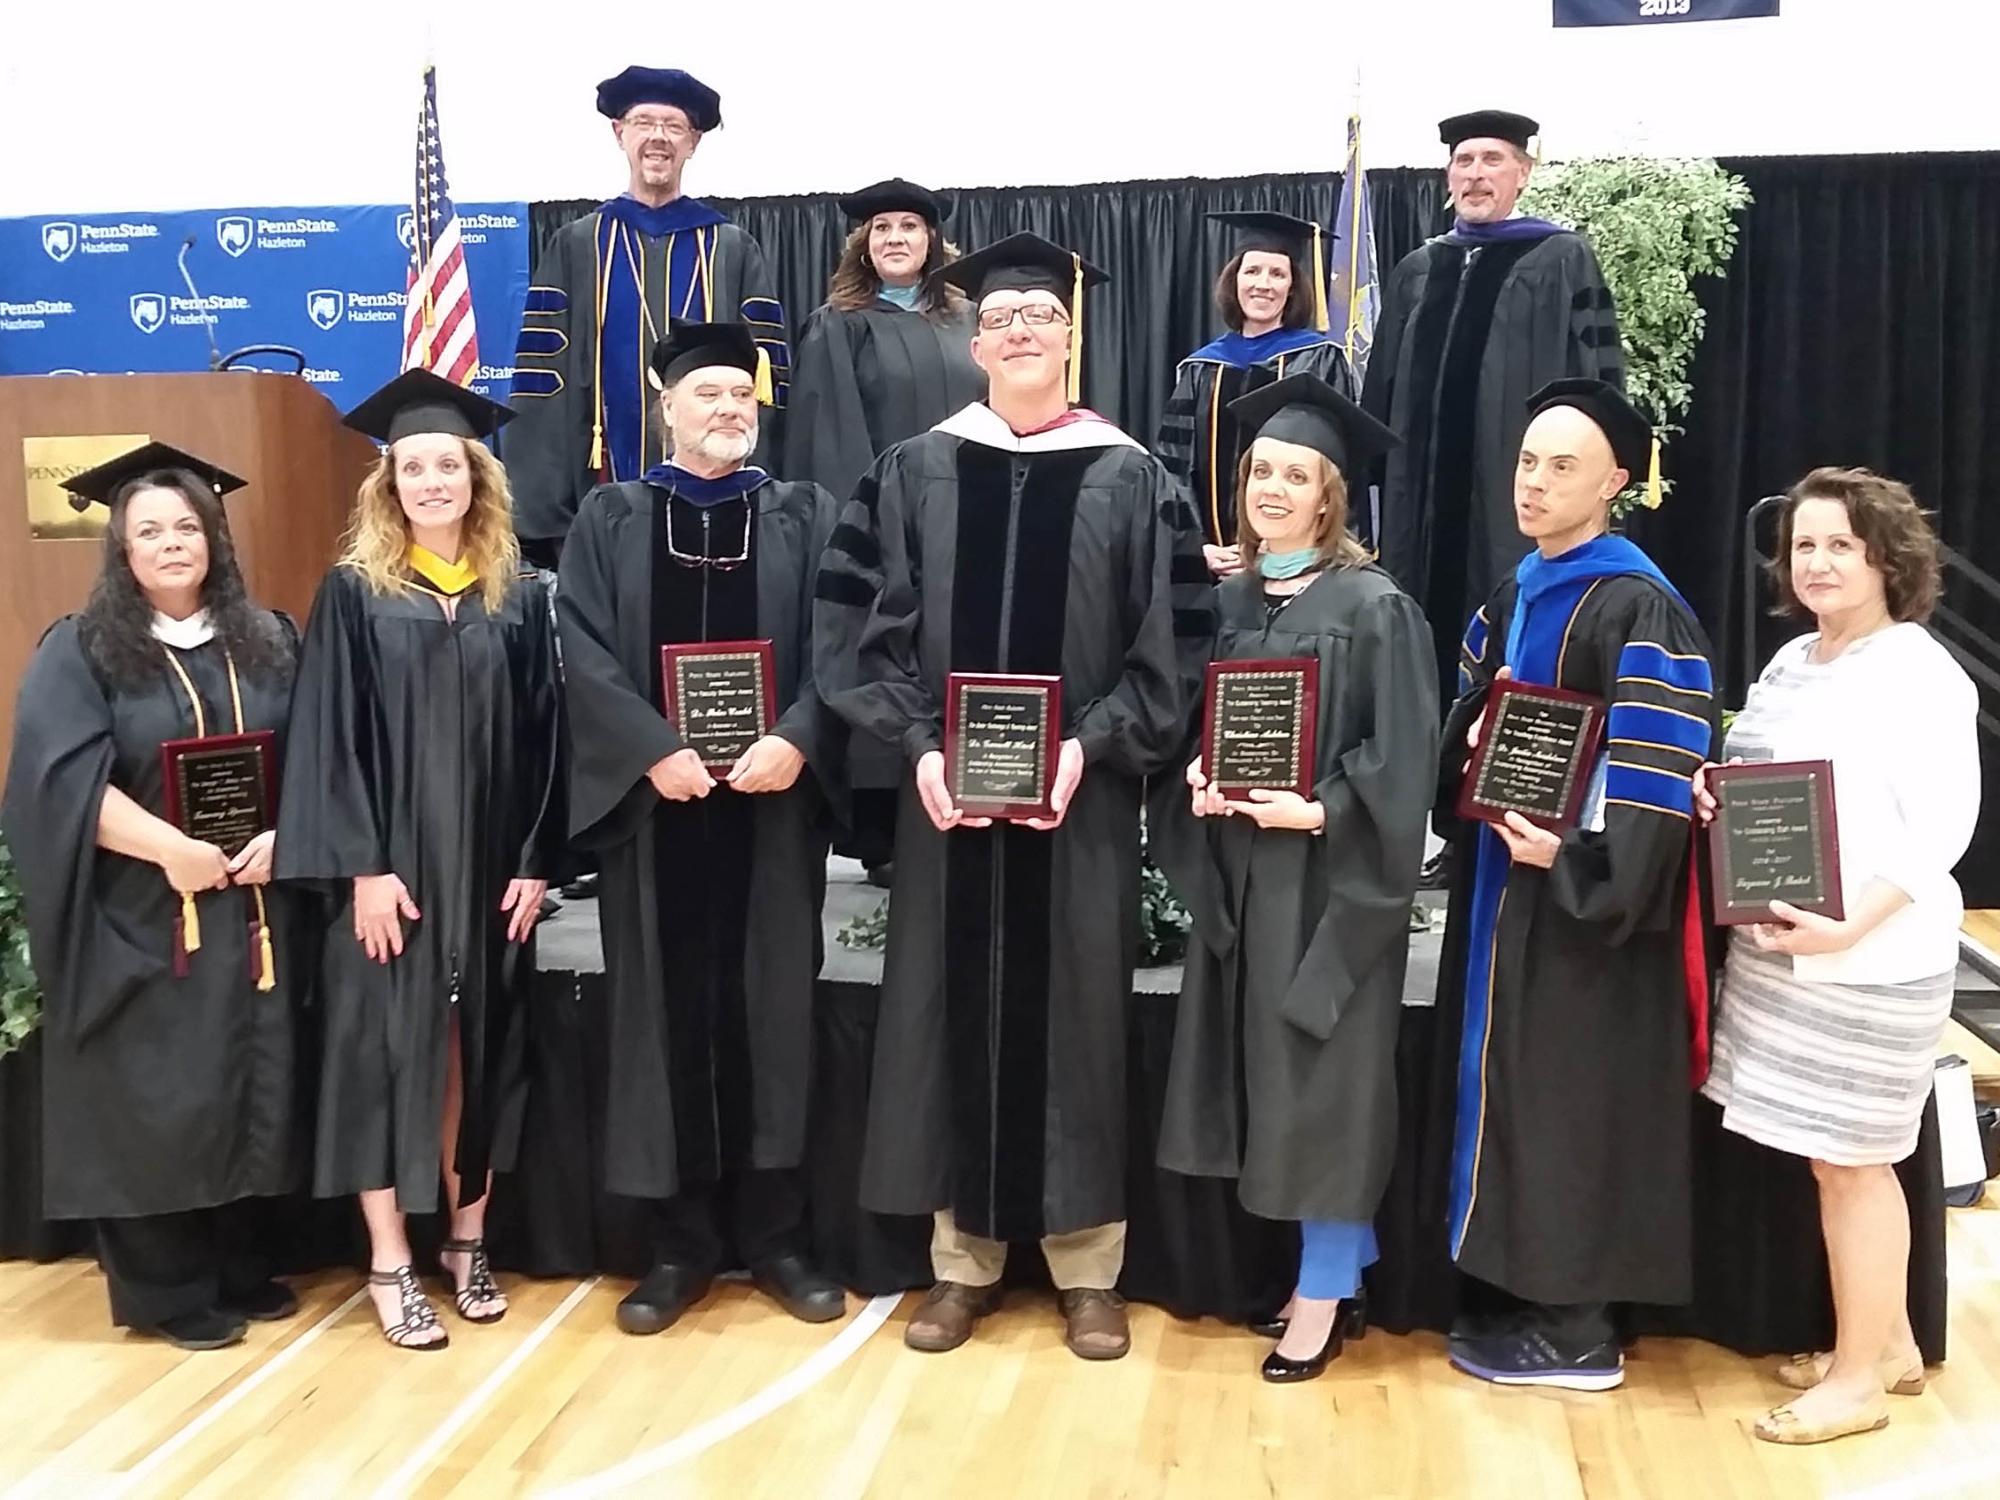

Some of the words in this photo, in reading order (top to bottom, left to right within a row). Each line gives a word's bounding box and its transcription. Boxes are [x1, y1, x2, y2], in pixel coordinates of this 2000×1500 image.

[257, 219, 339, 233] PennState
[460, 213, 518, 228] nnState
[81, 224, 160, 238] PennState
[257, 237, 306, 248] Hazleton
[461, 233, 487, 244] eton
[81, 242, 129, 253] Hazleton
[170, 296, 251, 310] PennState
[348, 310, 396, 322] Hazleton
[301, 368, 344, 382] State
